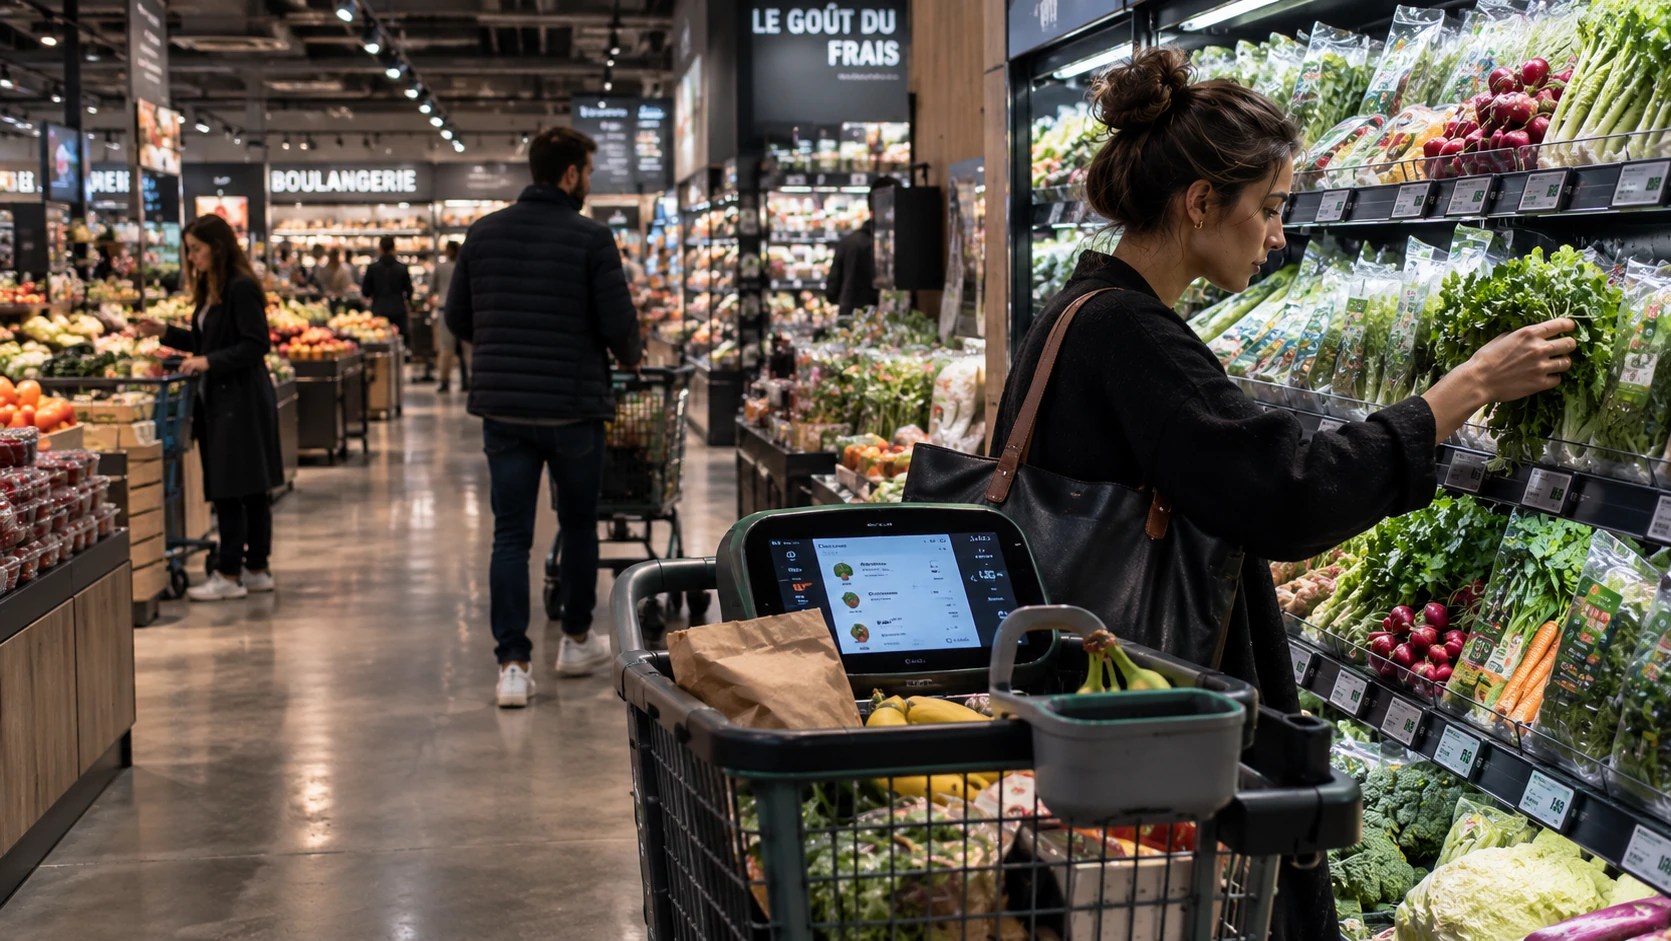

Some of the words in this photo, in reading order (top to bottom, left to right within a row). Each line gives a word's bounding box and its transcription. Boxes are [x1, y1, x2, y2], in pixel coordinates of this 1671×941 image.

[752, 8, 781, 34] LE
[787, 2, 854, 35] GOÛT
[860, 8, 896, 35] DU
[828, 40, 900, 66] FRAIS
[271, 169, 417, 193] BOULANGERIE
